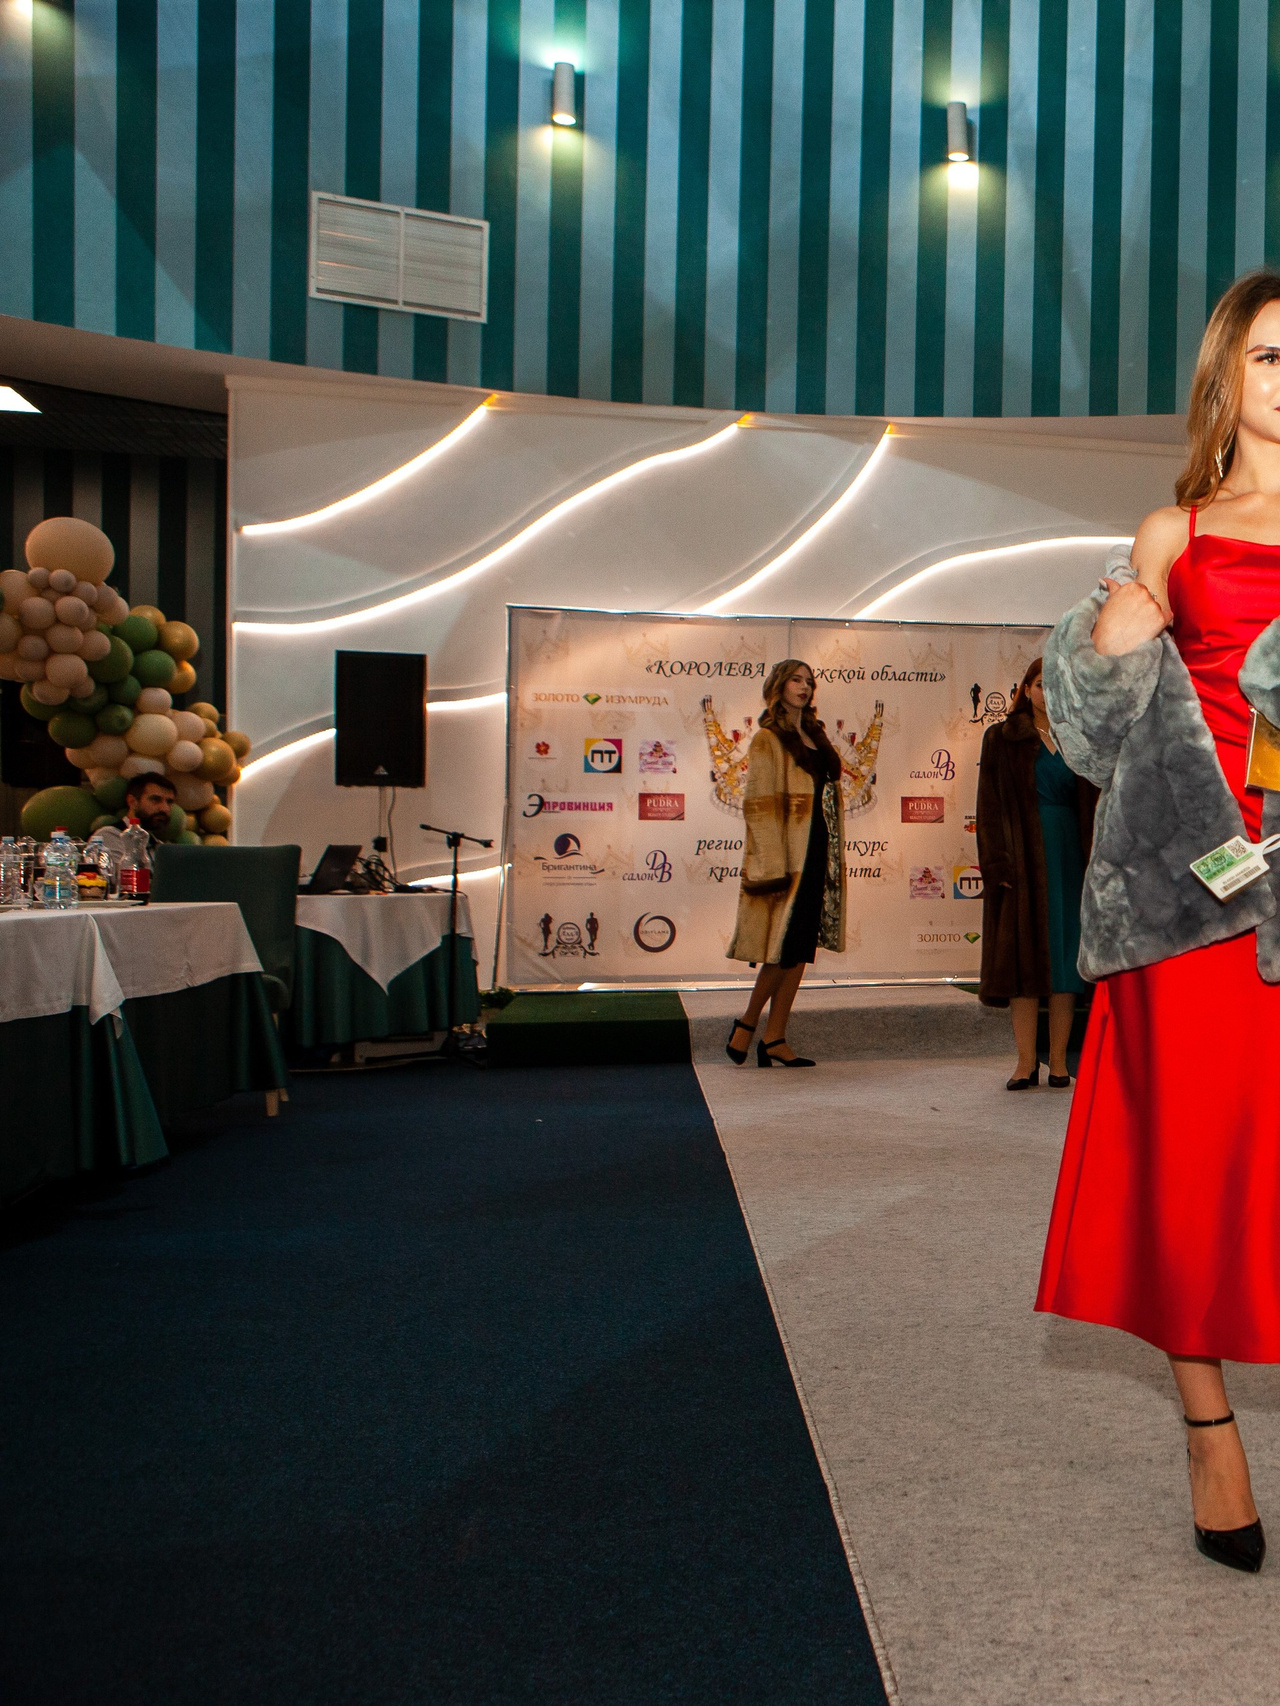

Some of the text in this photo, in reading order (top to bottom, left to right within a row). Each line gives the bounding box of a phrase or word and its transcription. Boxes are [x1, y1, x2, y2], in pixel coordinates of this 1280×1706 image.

[645, 660, 946, 684] «КОРОЛЕВА жской области»
[532, 693, 669, 706] ЗОЛОТО ИЗУМРУДА
[590, 750, 616, 763] ПТ
[909, 769, 938, 779] салон
[646, 798, 679, 808] PUDRA
[908, 802, 938, 811] PUDRA
[844, 840, 889, 857] нкурс
[541, 862, 597, 873] Бригантина
[622, 872, 653, 881] салон
[917, 933, 961, 943] ЗОЛОТО
